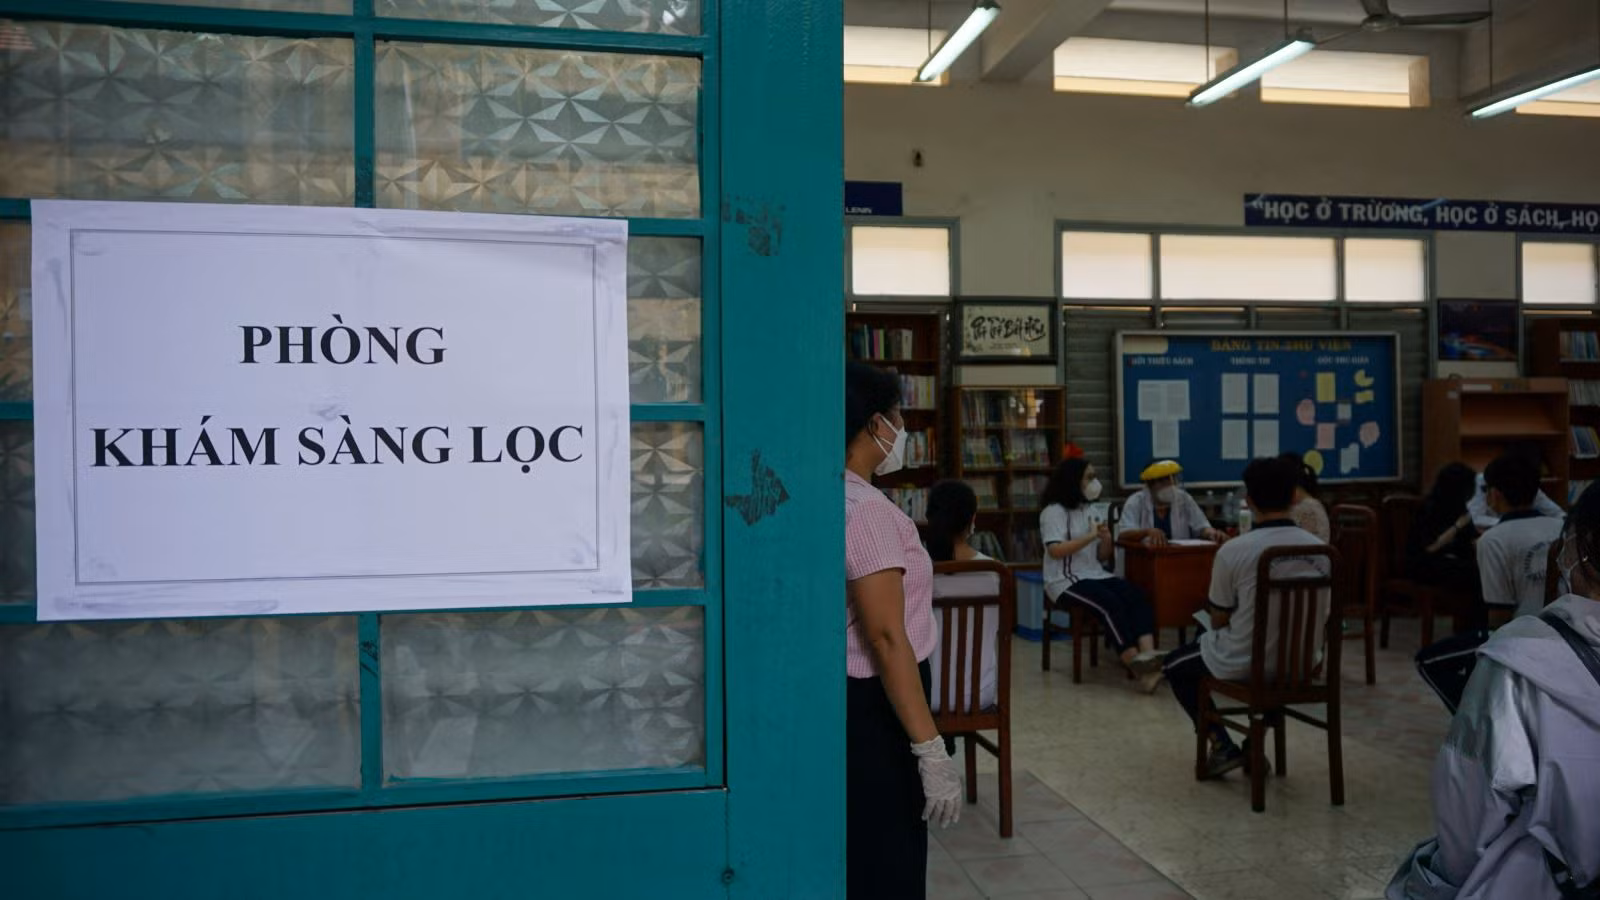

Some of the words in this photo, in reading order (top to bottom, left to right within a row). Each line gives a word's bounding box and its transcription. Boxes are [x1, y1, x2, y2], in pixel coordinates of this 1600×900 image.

[1316, 196, 1333, 221] Ở
[1436, 206, 1478, 228] HỌC
[1484, 202, 1499, 225] Ở
[239, 313, 446, 366] PHÒNG
[91, 415, 280, 468] KHÁM
[298, 414, 452, 466] SÀNG
[470, 424, 583, 474] LỌC
